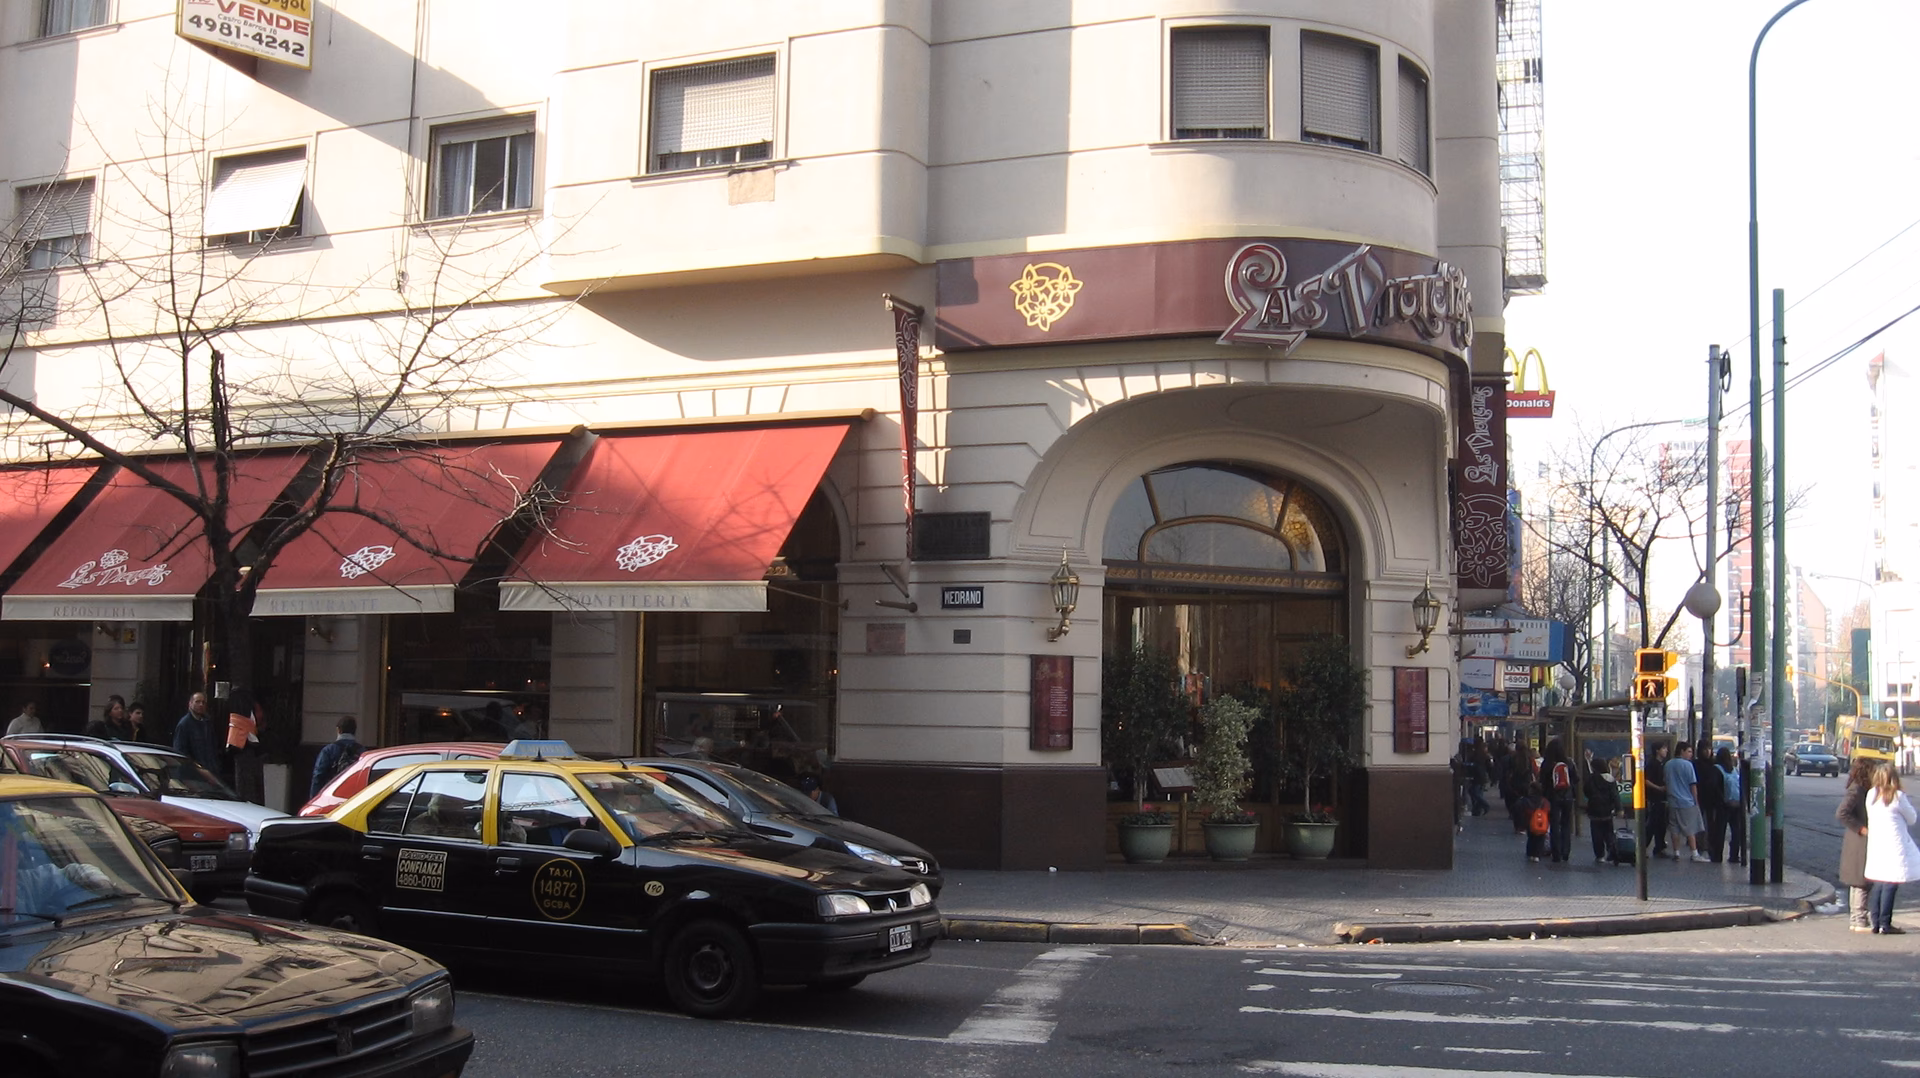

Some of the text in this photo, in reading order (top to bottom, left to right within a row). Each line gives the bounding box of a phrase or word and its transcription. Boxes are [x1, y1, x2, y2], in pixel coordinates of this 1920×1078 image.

[216, 0, 310, 36] VENDE
[217, 13, 242, 25] Castro
[243, 20, 267, 31] Barros
[188, 14, 305, 57] 4981-4242
[944, 591, 982, 605] MEDRANO
[53, 606, 135, 617] REPOSTERIA
[270, 599, 379, 613] RESTAURANTE
[399, 860, 442, 875] CONFIANZA
[549, 867, 573, 879] TAXI
[398, 873, 441, 888] 4860-0707
[540, 879, 578, 898] 14872
